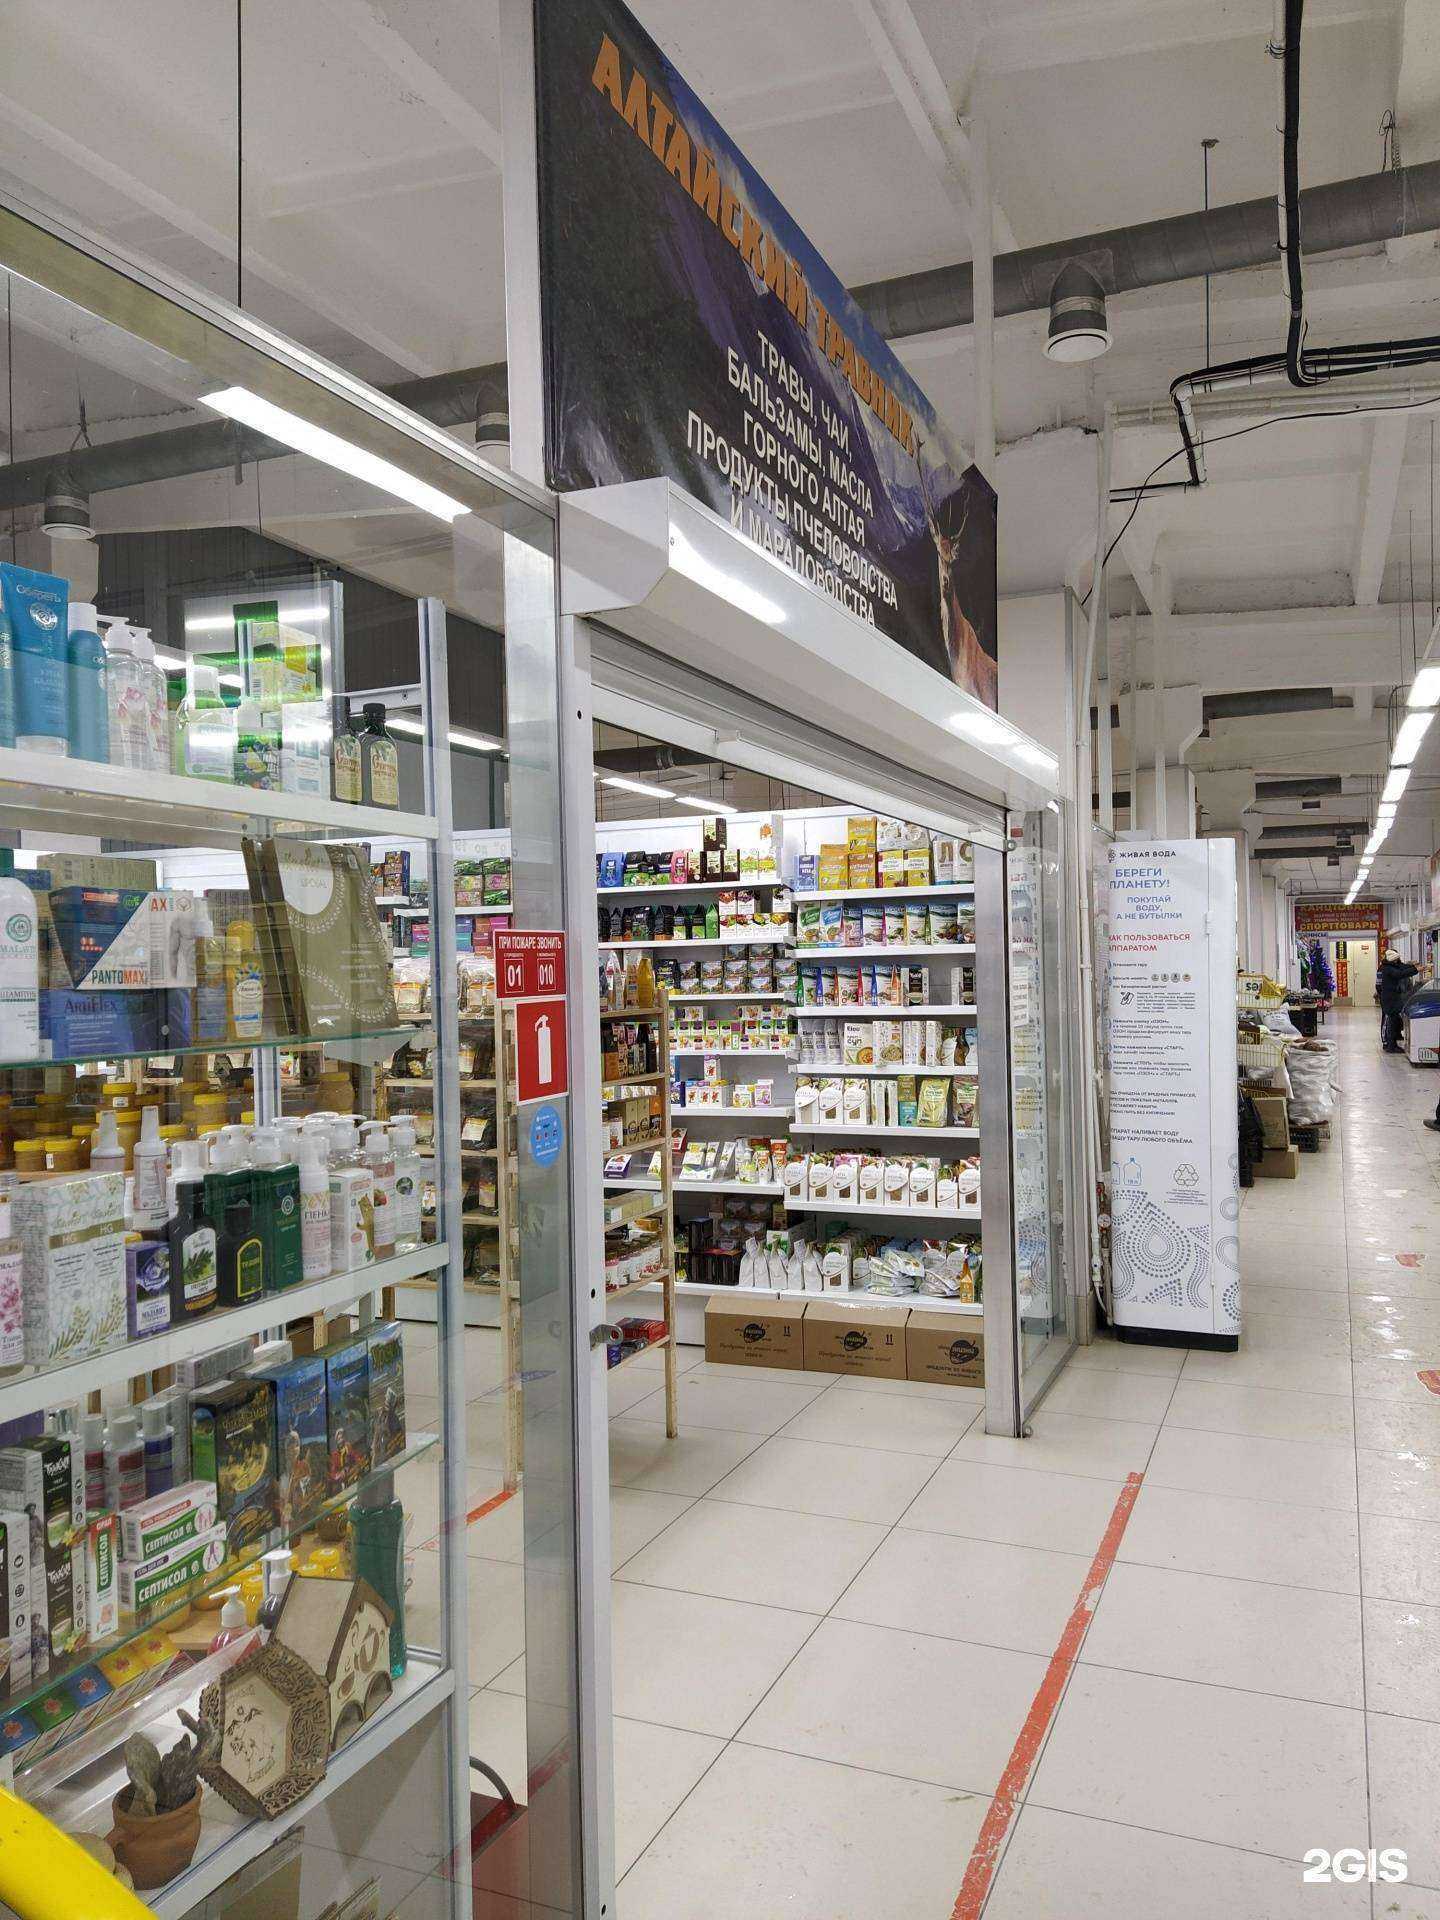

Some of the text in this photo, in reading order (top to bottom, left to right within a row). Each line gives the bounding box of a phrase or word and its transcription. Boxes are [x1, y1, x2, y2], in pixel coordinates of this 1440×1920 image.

[592, 32, 914, 457] АЛТАЙСКИЙ ТРАВНИК
[758, 330, 852, 462] ТРАВЫ, ЧАИ,
[727, 346, 874, 518] БАЛЬЗАМЫ, МАСЛА
[743, 410, 865, 547] ГОРНОГО АЛТАЯ
[687, 409, 898, 611] ПРОДУКТЫ ПЧЕЛОВОДСТВА
[730, 495, 743, 530] И
[1152, 850, 1177, 858] ВОДА
[1109, 879, 1170, 889] ПЛАНЕТУ!
[1115, 868, 1162, 878] БЕРЕГИ
[1127, 895, 1171, 903] ПОКУПАЙ
[1138, 912, 1183, 920] БУТЫЛКИ
[498, 936, 562, 949] ПРИ ПОЖАРЕ ЗВОНИТЬ
[1124, 933, 1191, 941] ПОЛЬЗОВАТЬСЯ
[92, 969, 145, 985] PANTOMAX
[507, 964, 554, 987] 01 010
[145, 1526, 184, 1554] СЕПТИСОЛ
[99, 1533, 109, 1587] СЕПТИСОЛ
[138, 1565, 188, 1602] СЕПТИСОЛ
